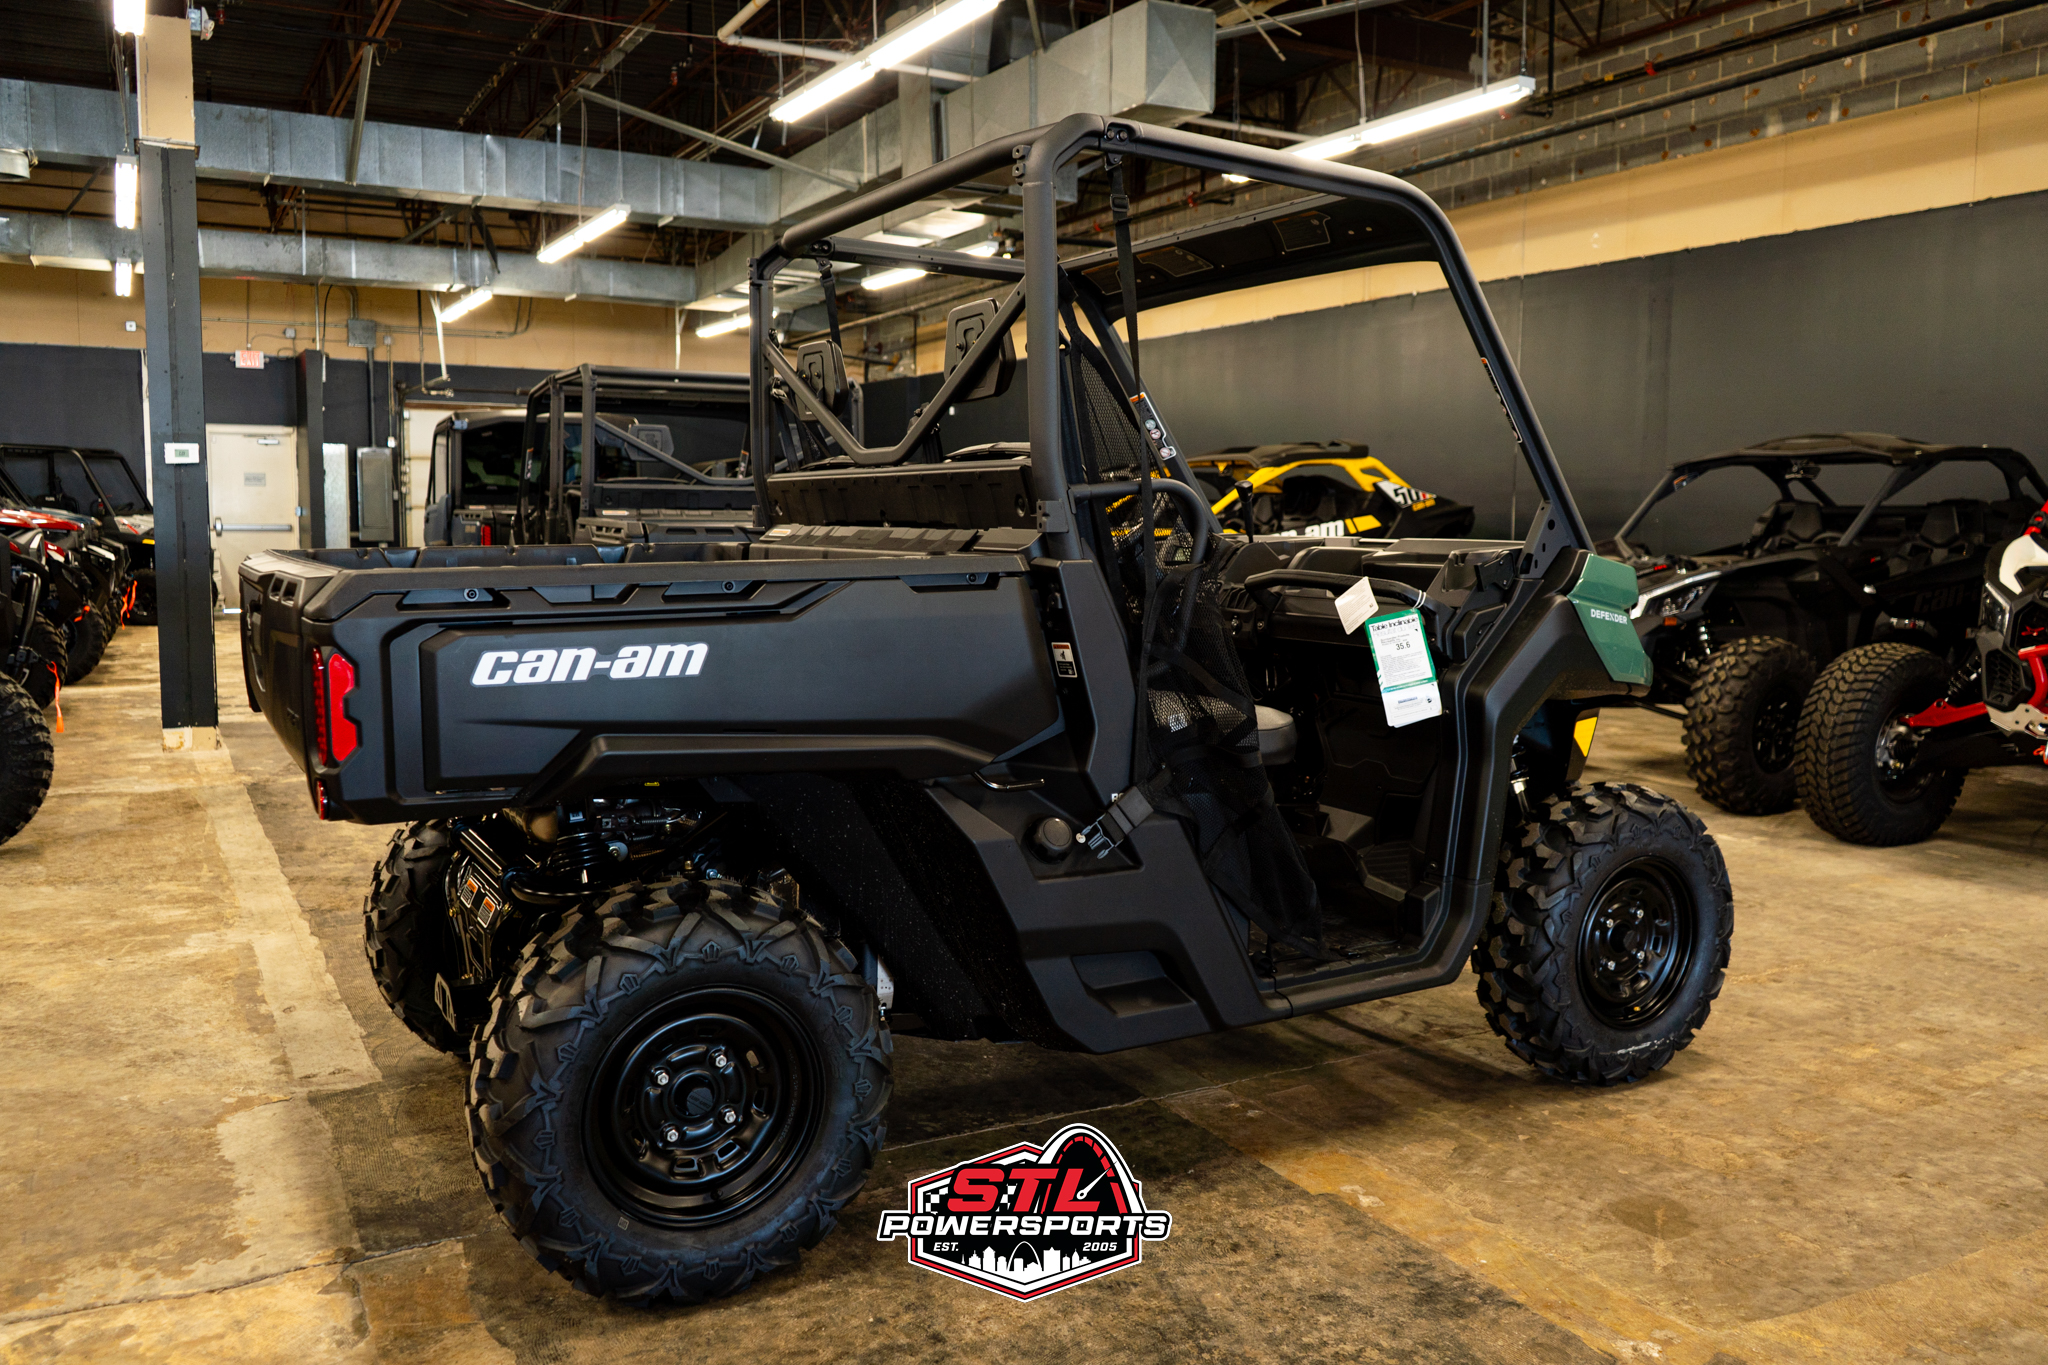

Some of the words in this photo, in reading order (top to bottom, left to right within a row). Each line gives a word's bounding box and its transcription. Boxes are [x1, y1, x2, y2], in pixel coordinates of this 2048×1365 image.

[240, 351, 260, 367] EXIT
[1590, 608, 1628, 625] DEFENDER
[1396, 642, 1411, 651] 35.6
[471, 643, 709, 686] can-am
